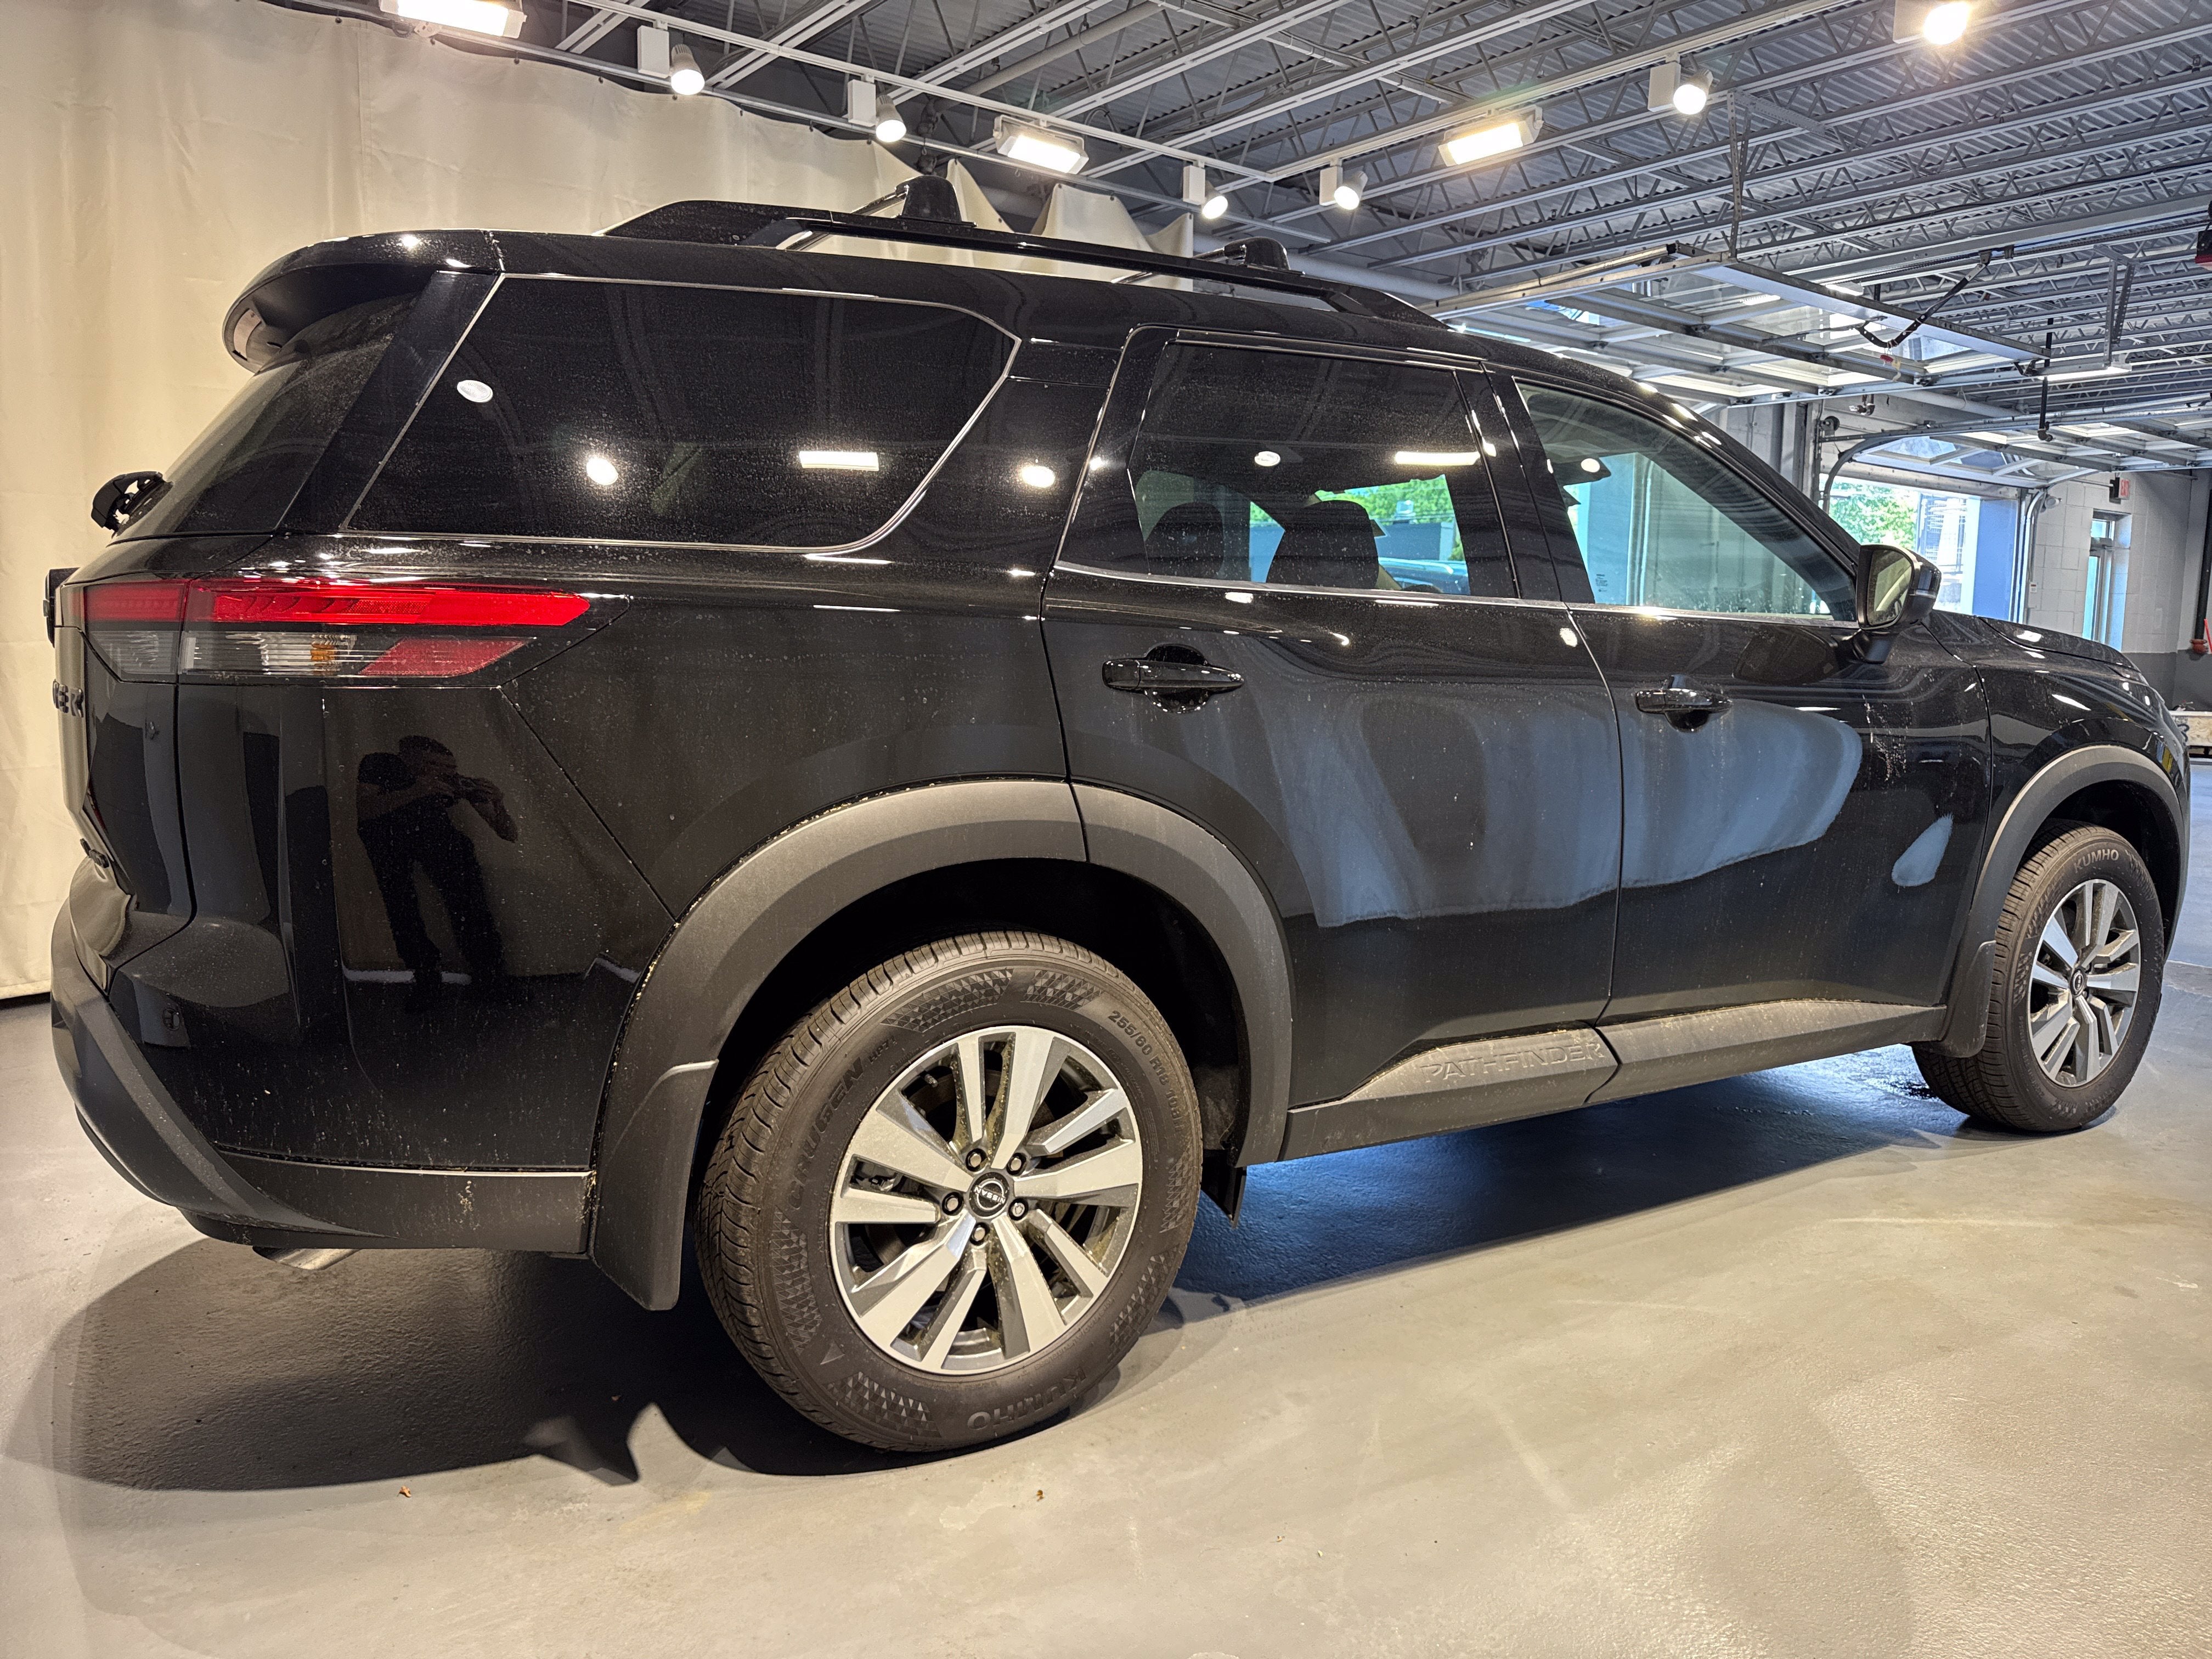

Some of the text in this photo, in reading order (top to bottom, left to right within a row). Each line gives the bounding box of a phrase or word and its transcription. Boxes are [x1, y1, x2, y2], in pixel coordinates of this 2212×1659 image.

[2074, 849, 2119, 874] KUMHO
[1108, 1010, 1153, 1056] 255/60
[1149, 1054, 1170, 1086] R18
[1420, 1043, 1604, 1083] PATHFINDER
[974, 1186, 1006, 1205] NISSAN
[967, 1365, 1087, 1431] KUMHO
